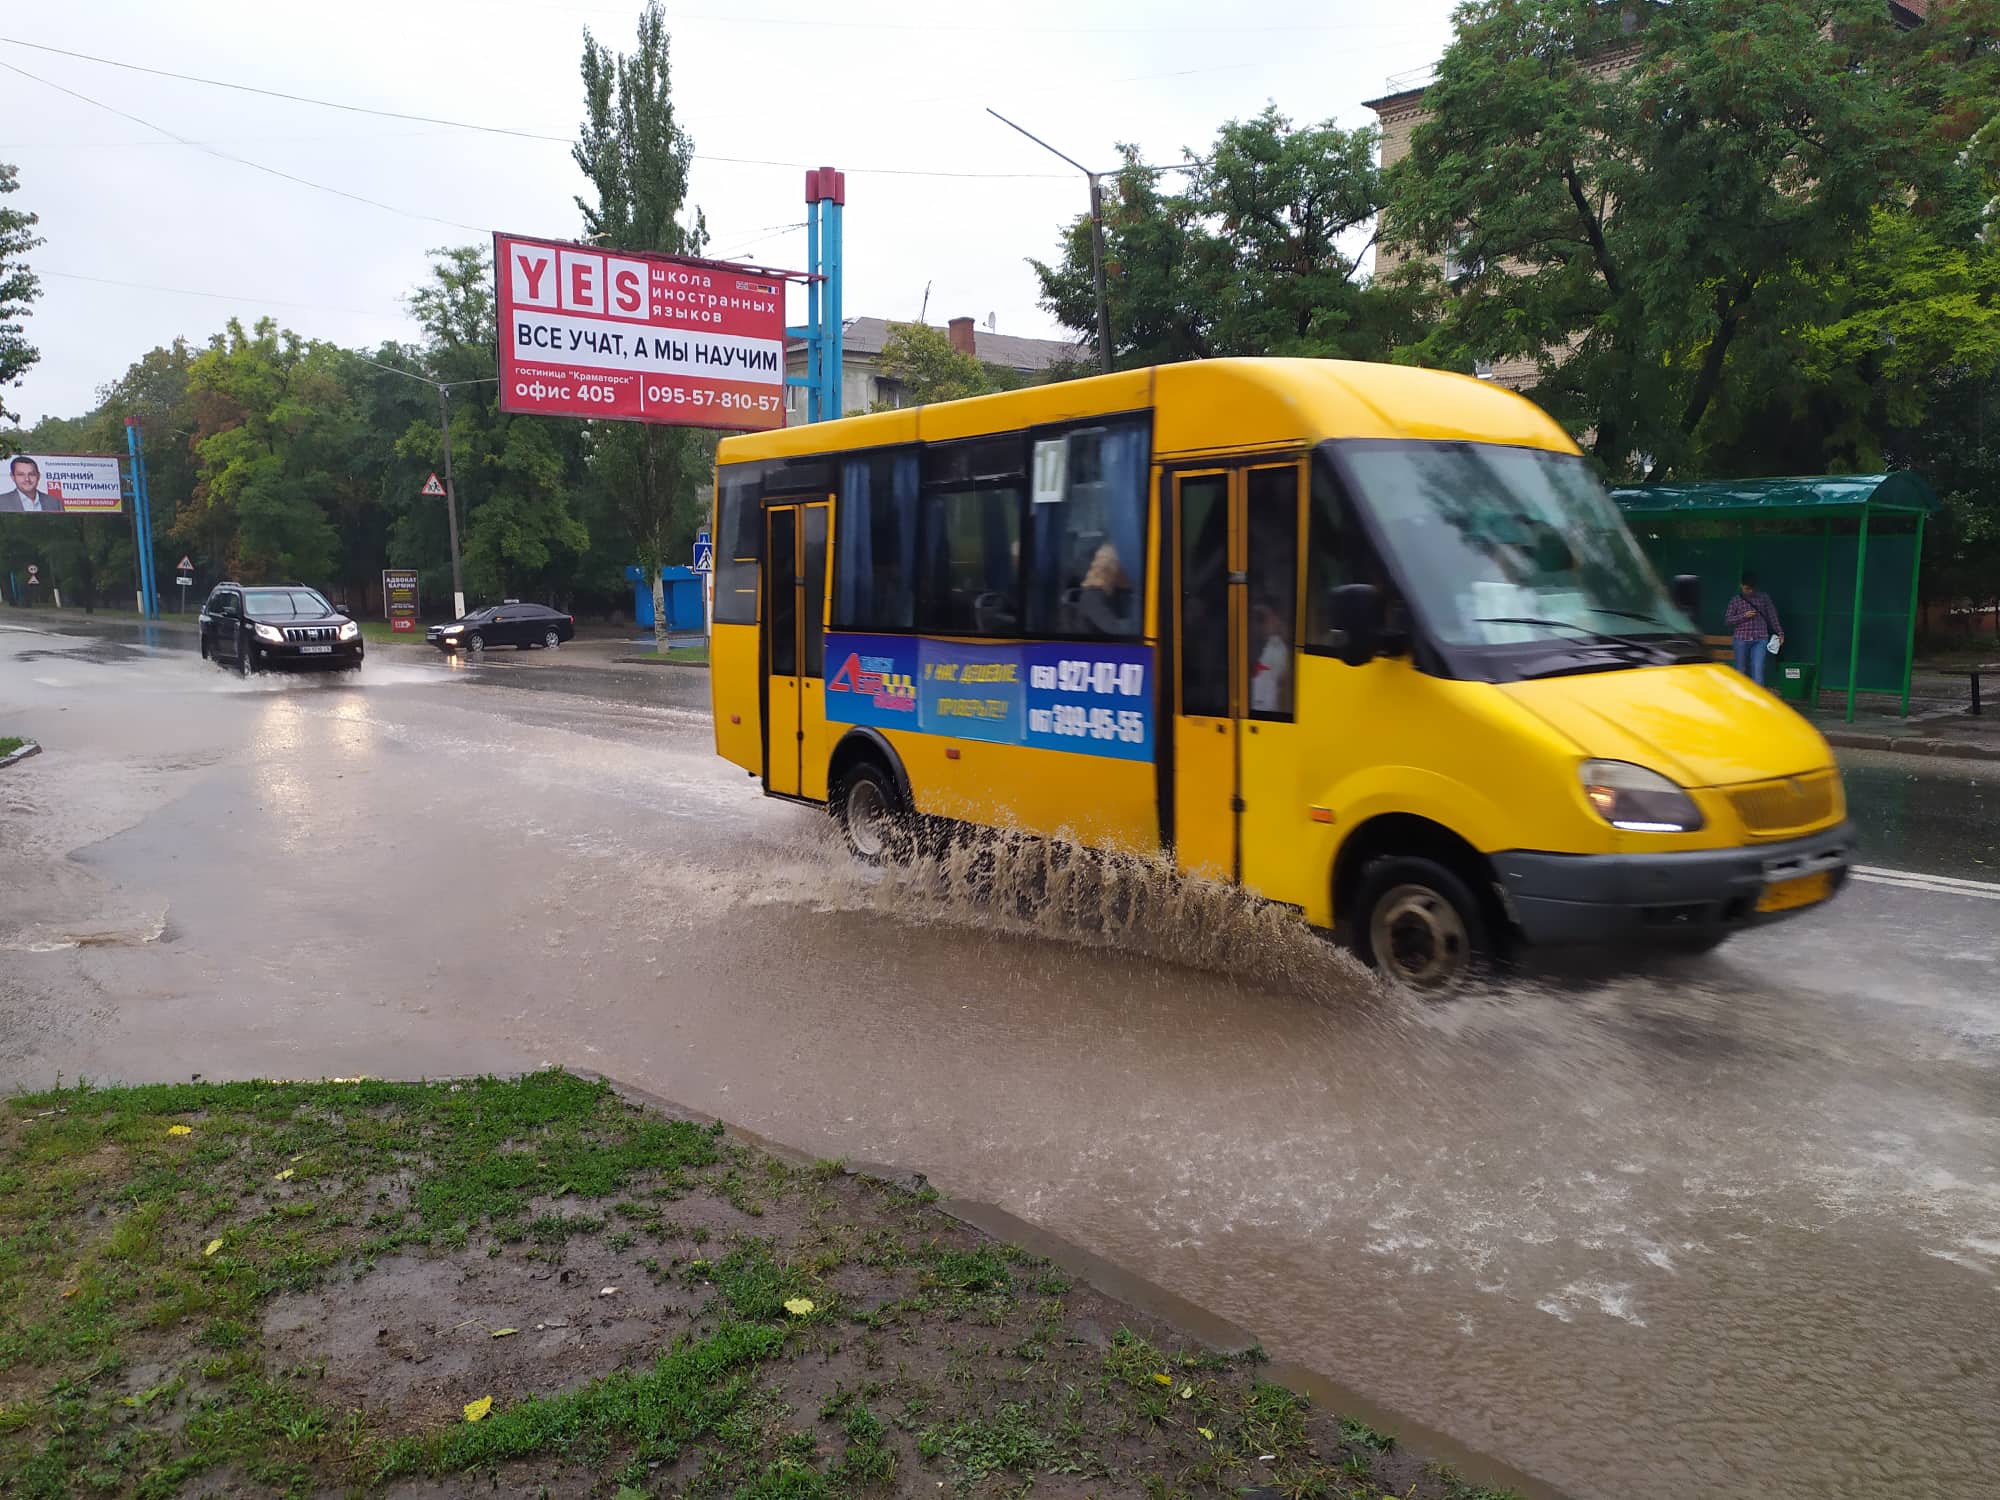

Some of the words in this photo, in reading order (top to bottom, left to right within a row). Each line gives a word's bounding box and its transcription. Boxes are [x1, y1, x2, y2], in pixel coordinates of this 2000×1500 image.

[517, 255, 641, 312] YES
[652, 268, 711, 288] школа
[652, 288, 776, 313] иностранных
[653, 305, 722, 323] языков
[518, 323, 562, 349] ВСЕ
[569, 329, 628, 360] УЧАТ,
[634, 337, 648, 358] А
[655, 340, 688, 362] МЫ
[695, 344, 777, 372] НАУЧИМ
[515, 367, 566, 380] гостиница
[568, 370, 634, 385] "Краматорск"
[515, 381, 570, 401] офис
[577, 385, 615, 403] 405
[648, 386, 780, 412] 095-57-810-57
[46, 471, 94, 480] ВДЯЧНИЙ
[48, 482, 60, 490] ЗА
